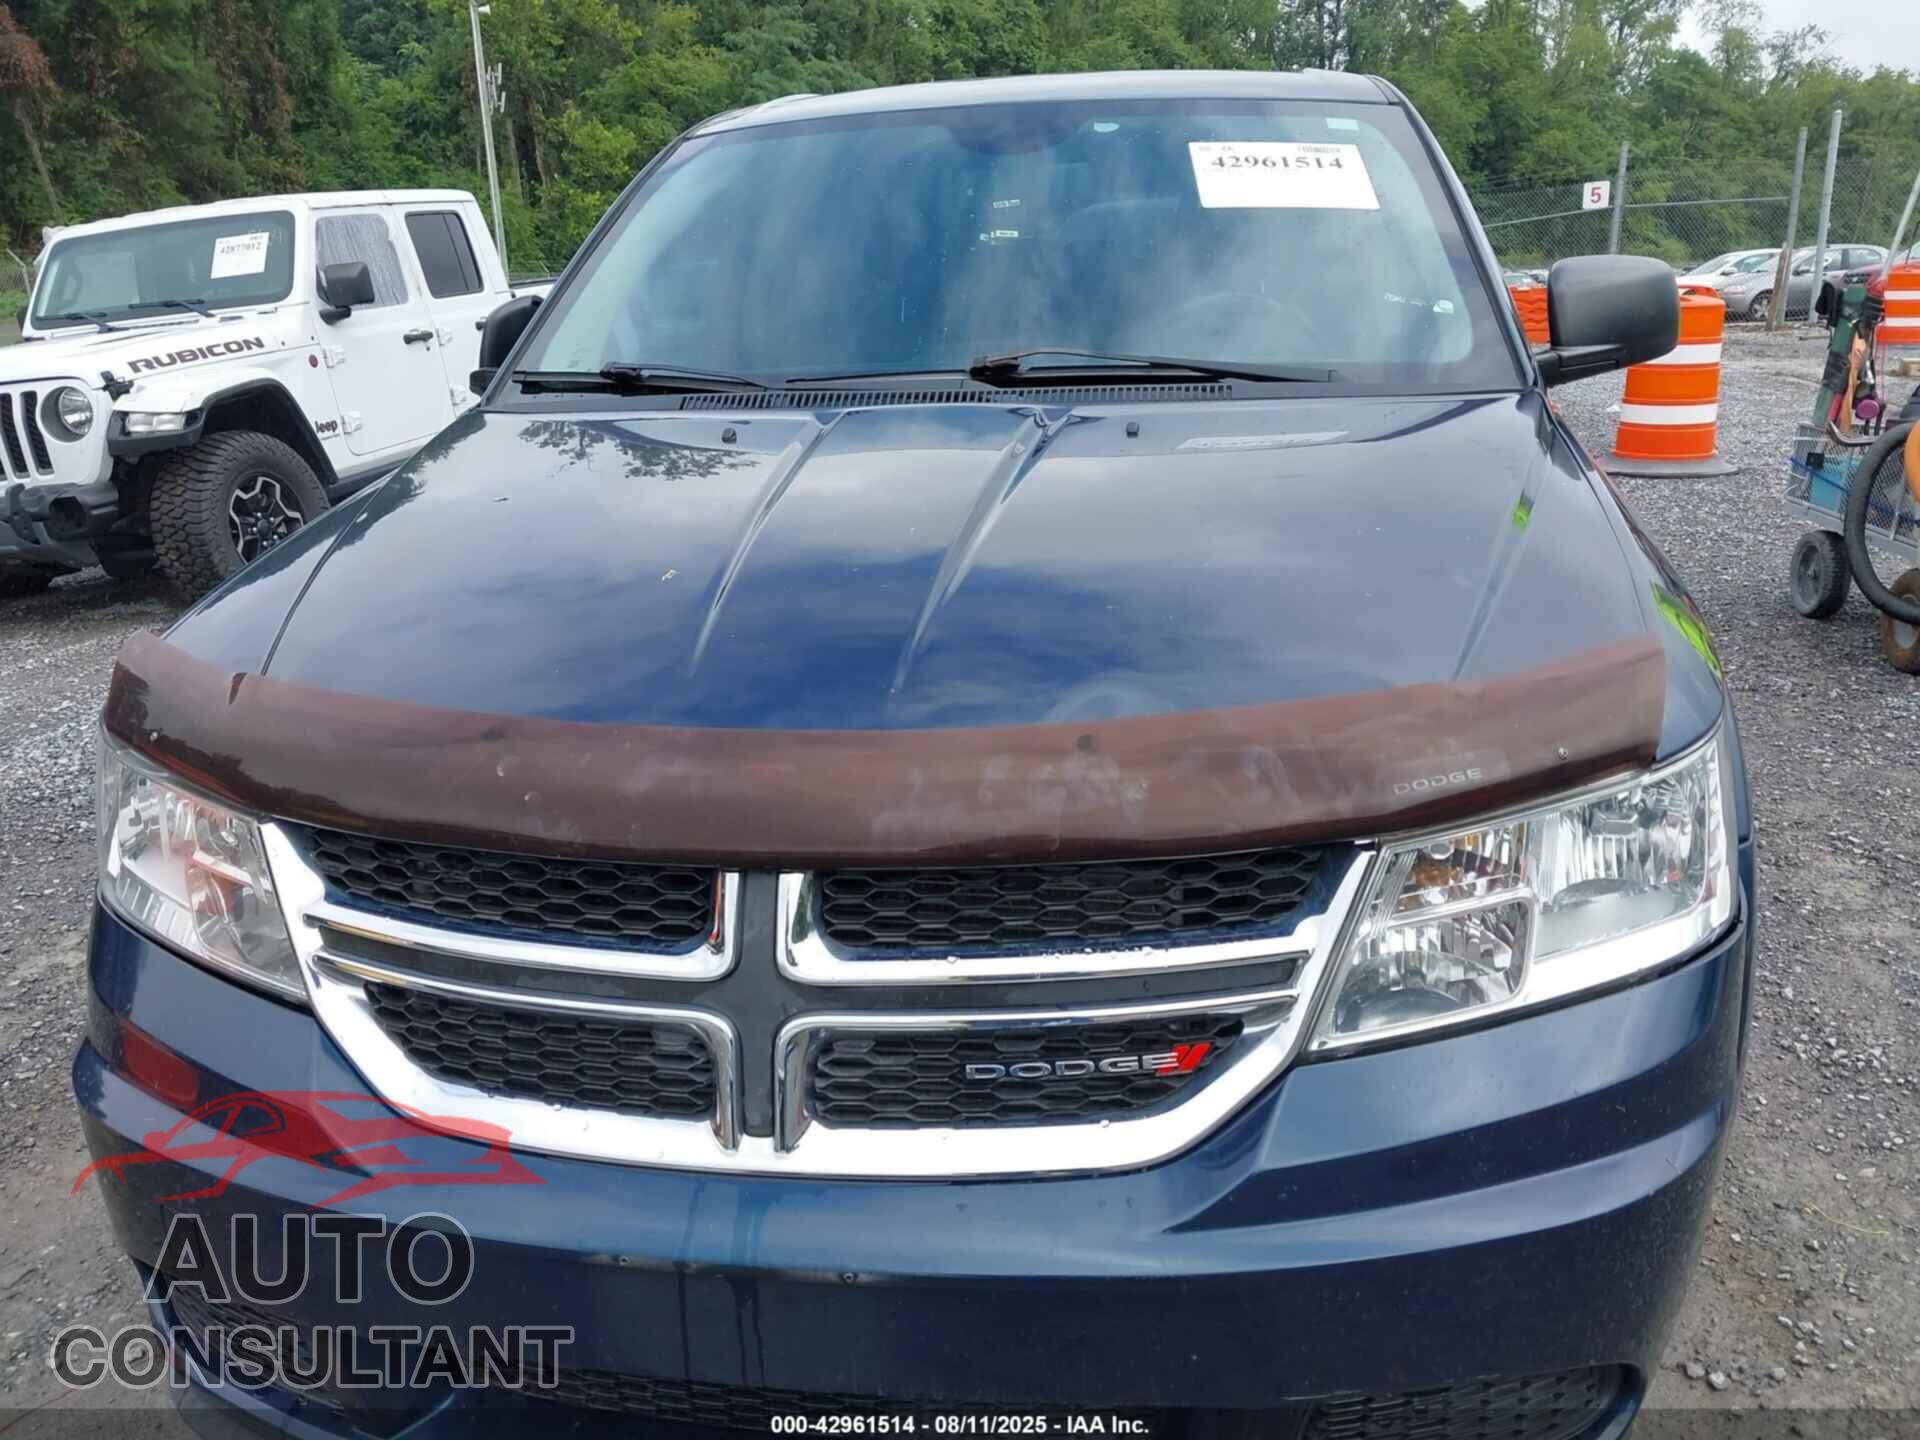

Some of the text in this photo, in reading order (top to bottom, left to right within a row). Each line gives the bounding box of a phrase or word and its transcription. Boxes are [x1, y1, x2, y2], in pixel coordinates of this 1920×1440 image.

[1211, 155, 1344, 169] 42961514
[1590, 187, 1602, 204] 5
[128, 337, 264, 373] RUBICON
[1392, 768, 1483, 795] DODGE
[965, 1052, 1178, 1079] DODGE
